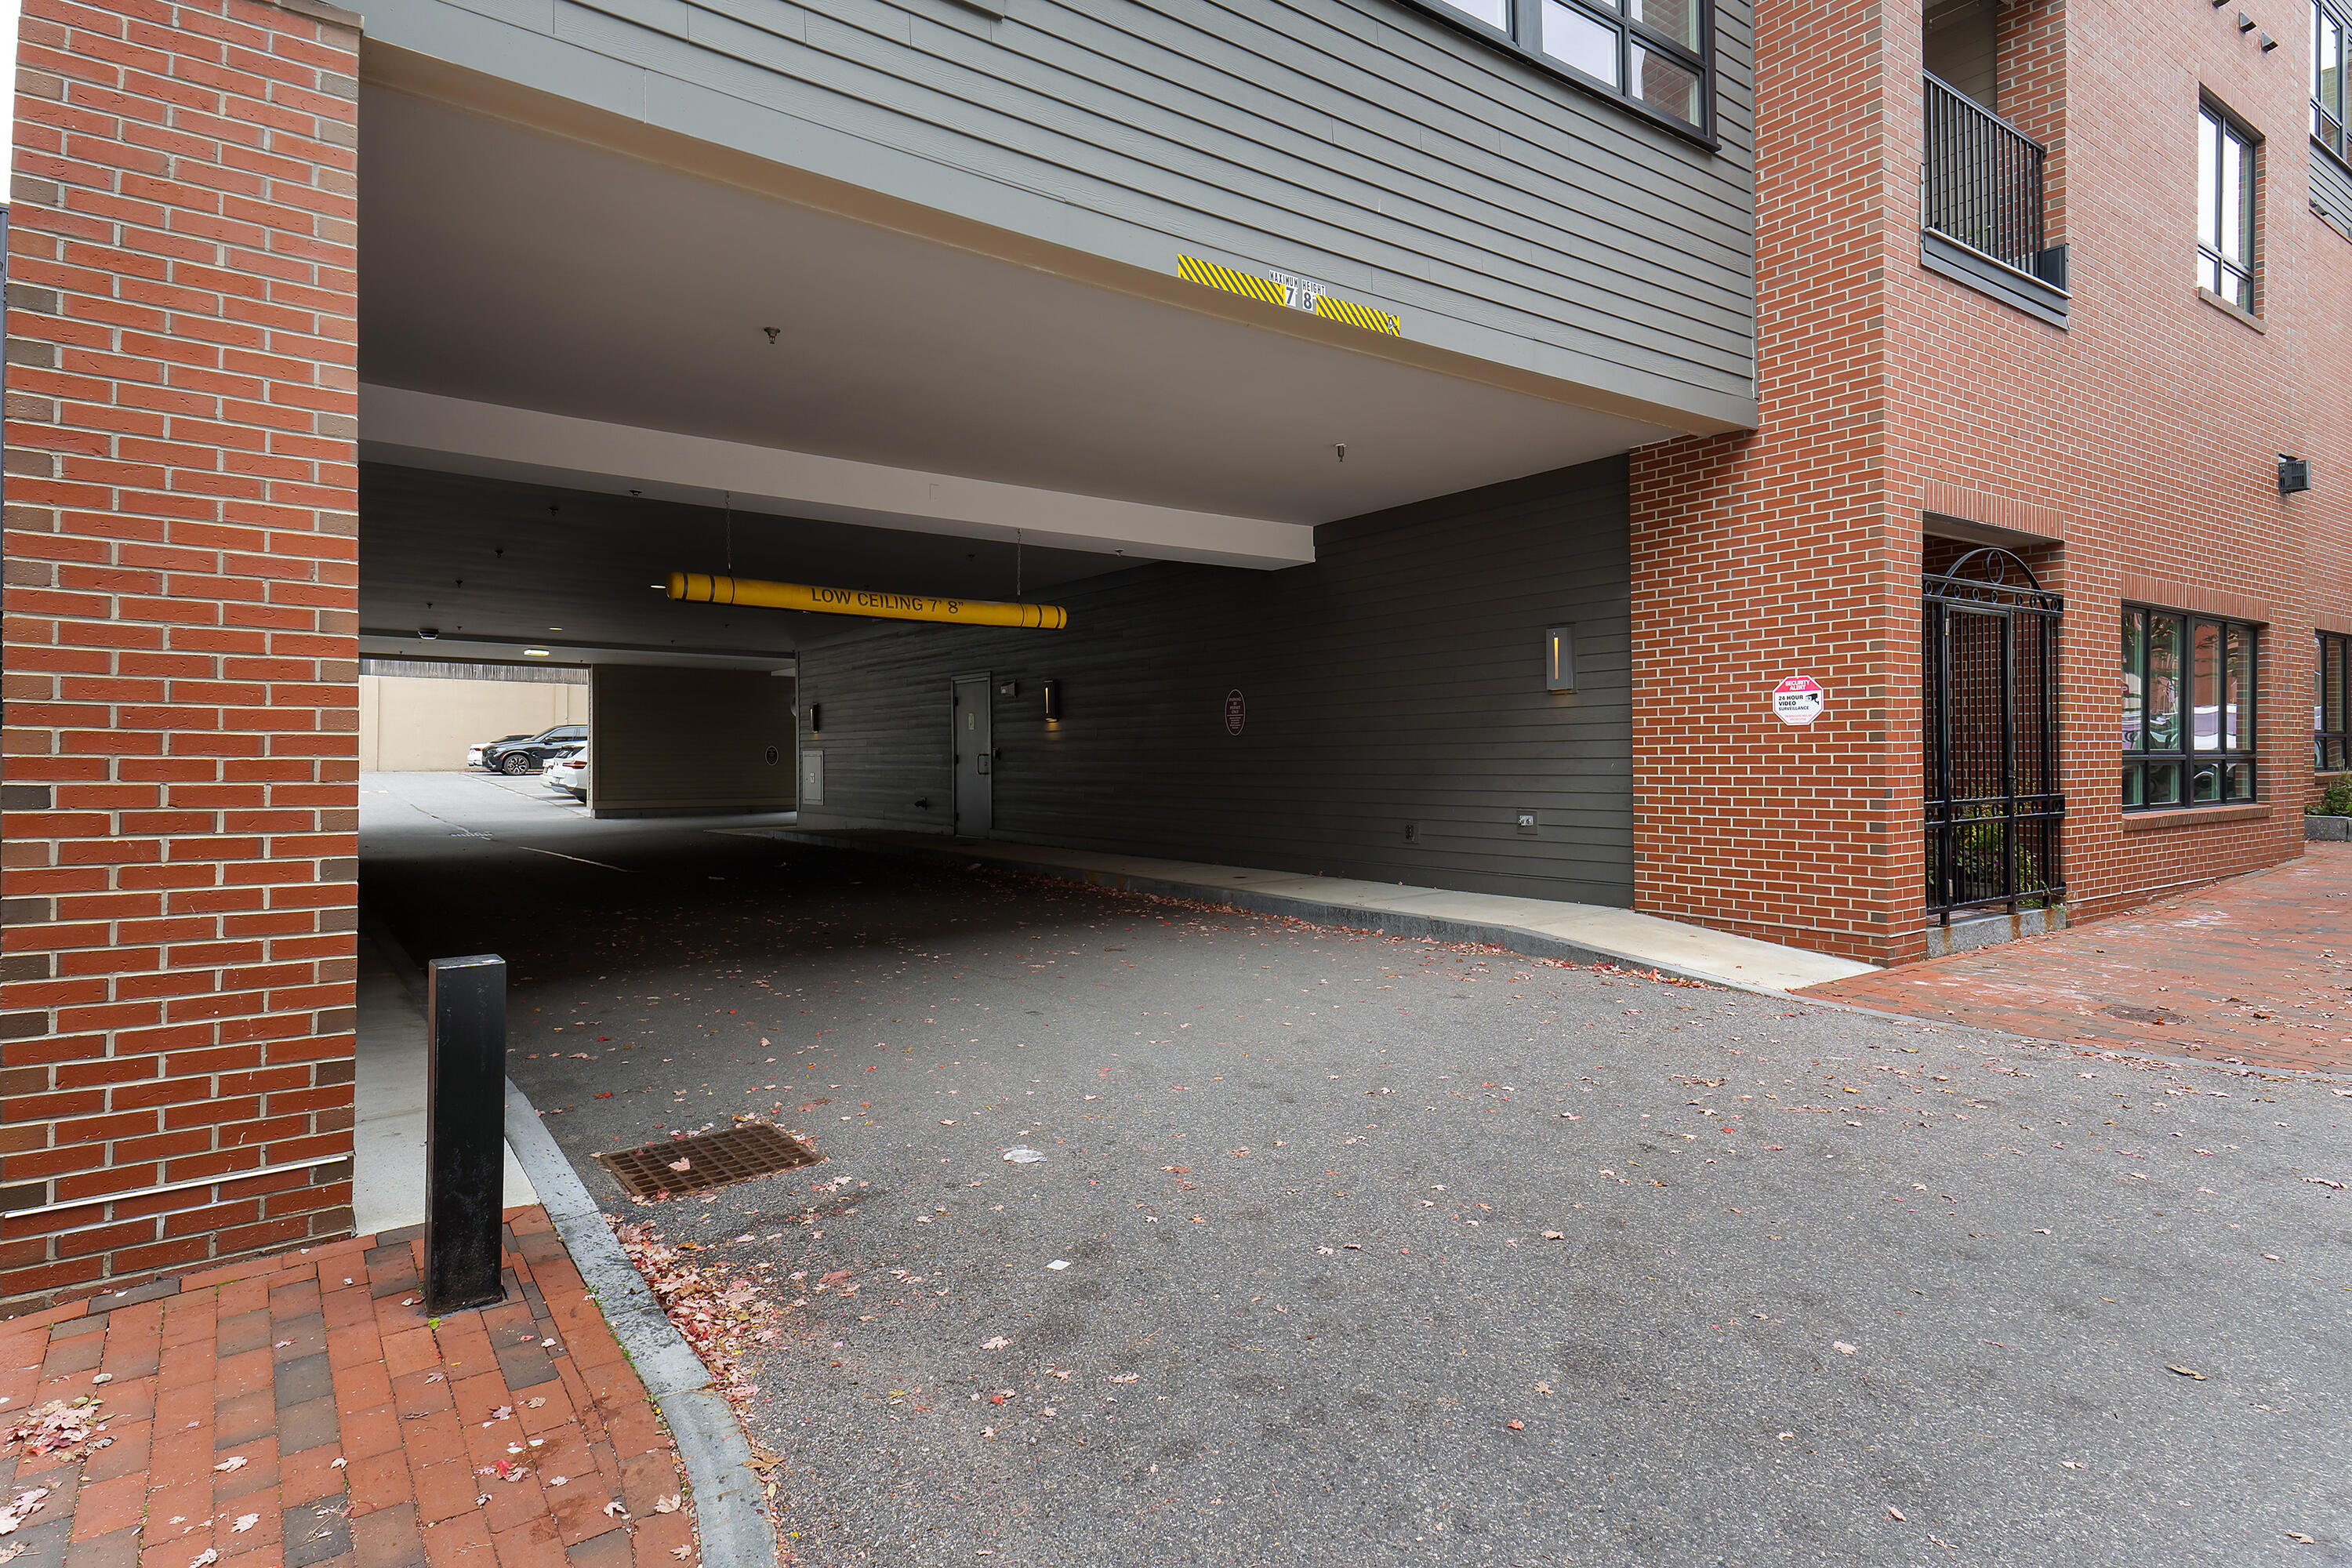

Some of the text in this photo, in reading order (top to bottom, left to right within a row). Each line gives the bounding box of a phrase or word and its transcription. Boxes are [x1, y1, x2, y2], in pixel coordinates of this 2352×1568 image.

[1269, 270, 1325, 296] MAXIMUM HEIGHT
[811, 587, 851, 604] LOW
[857, 592, 923, 612] CEILING
